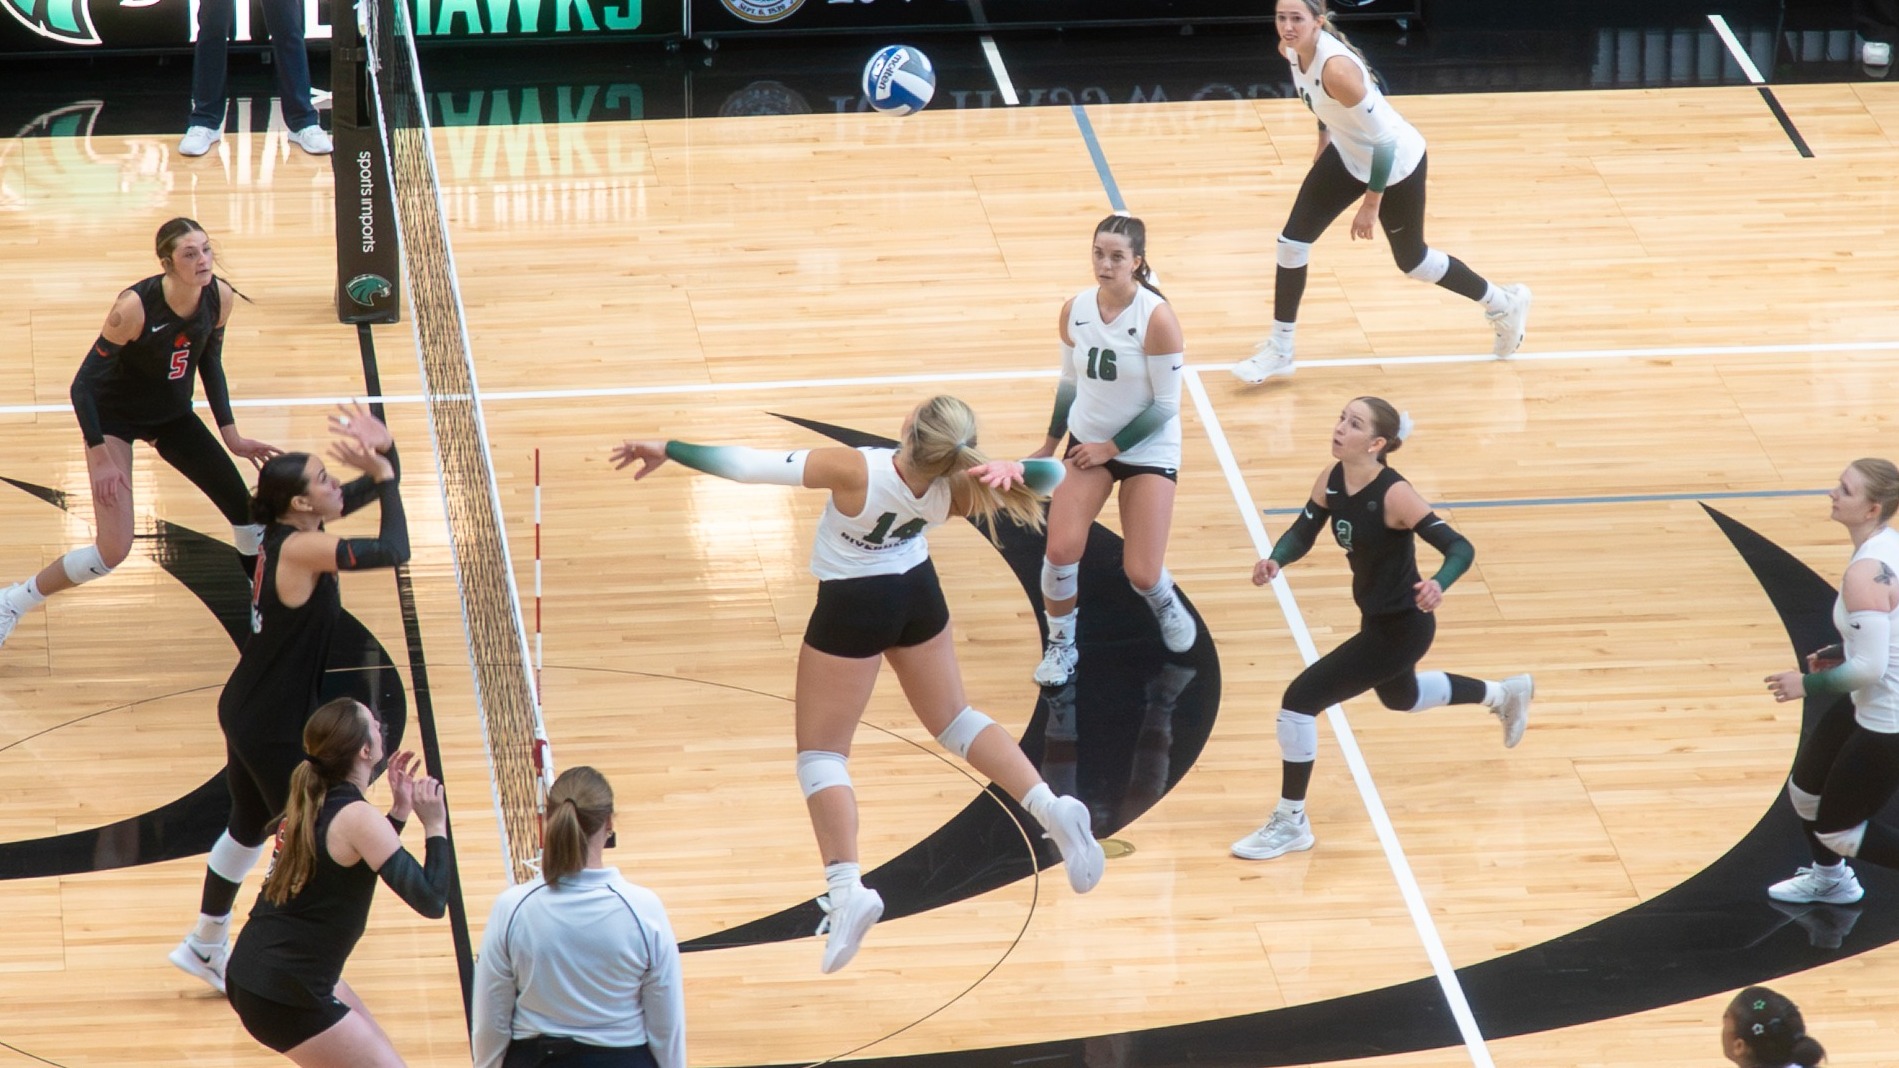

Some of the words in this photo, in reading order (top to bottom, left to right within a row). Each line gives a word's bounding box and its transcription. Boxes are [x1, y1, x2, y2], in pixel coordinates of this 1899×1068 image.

[878, 54, 902, 90] molten
[357, 151, 374, 196] sports
[359, 198, 376, 253] imports
[168, 349, 190, 380] 5
[1086, 346, 1118, 381] 16
[862, 511, 928, 545] 14
